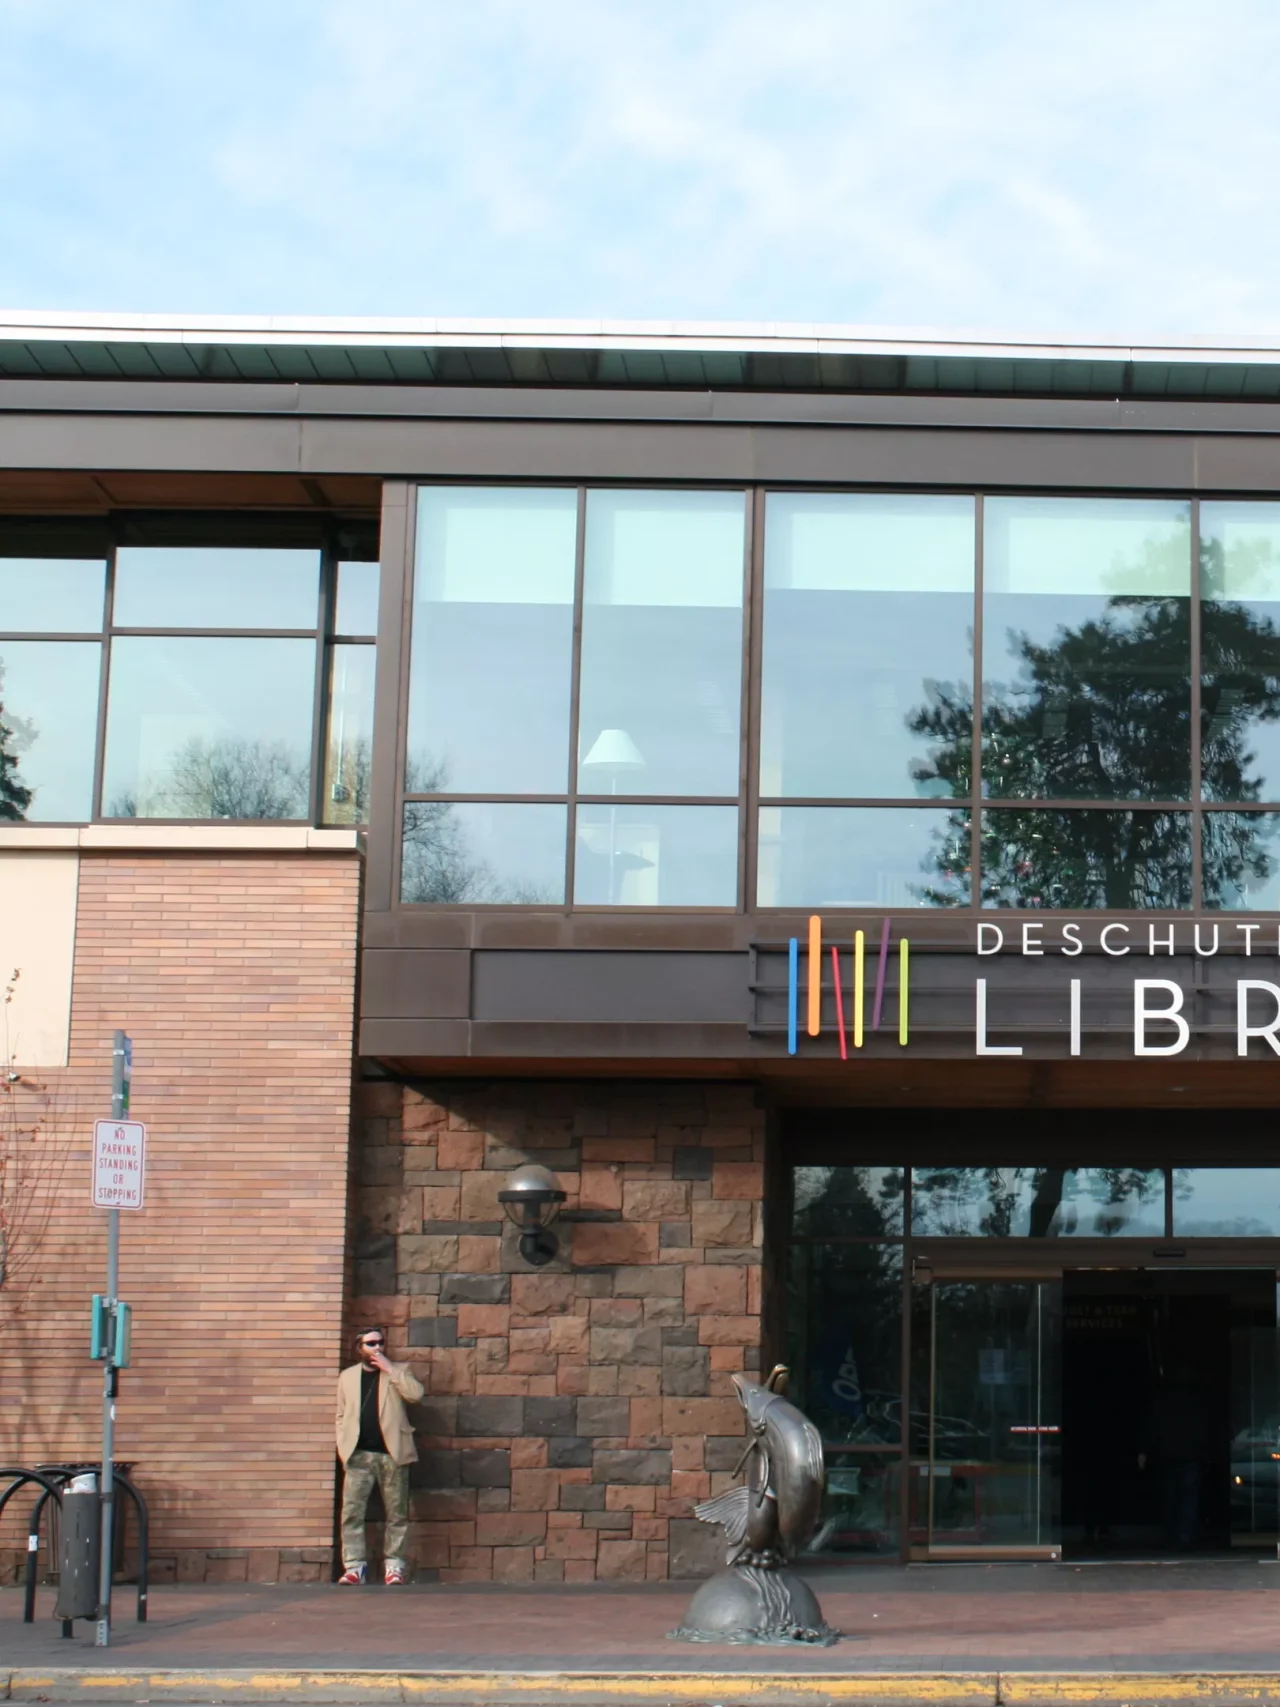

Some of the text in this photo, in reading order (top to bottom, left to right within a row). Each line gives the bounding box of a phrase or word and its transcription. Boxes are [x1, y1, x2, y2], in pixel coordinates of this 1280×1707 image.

[114, 1129, 126, 1141] NO
[102, 1143, 137, 1156] PARKING
[99, 1158, 138, 1171] STANDING
[113, 1174, 124, 1185] OR
[98, 1187, 137, 1201] STOPPING
